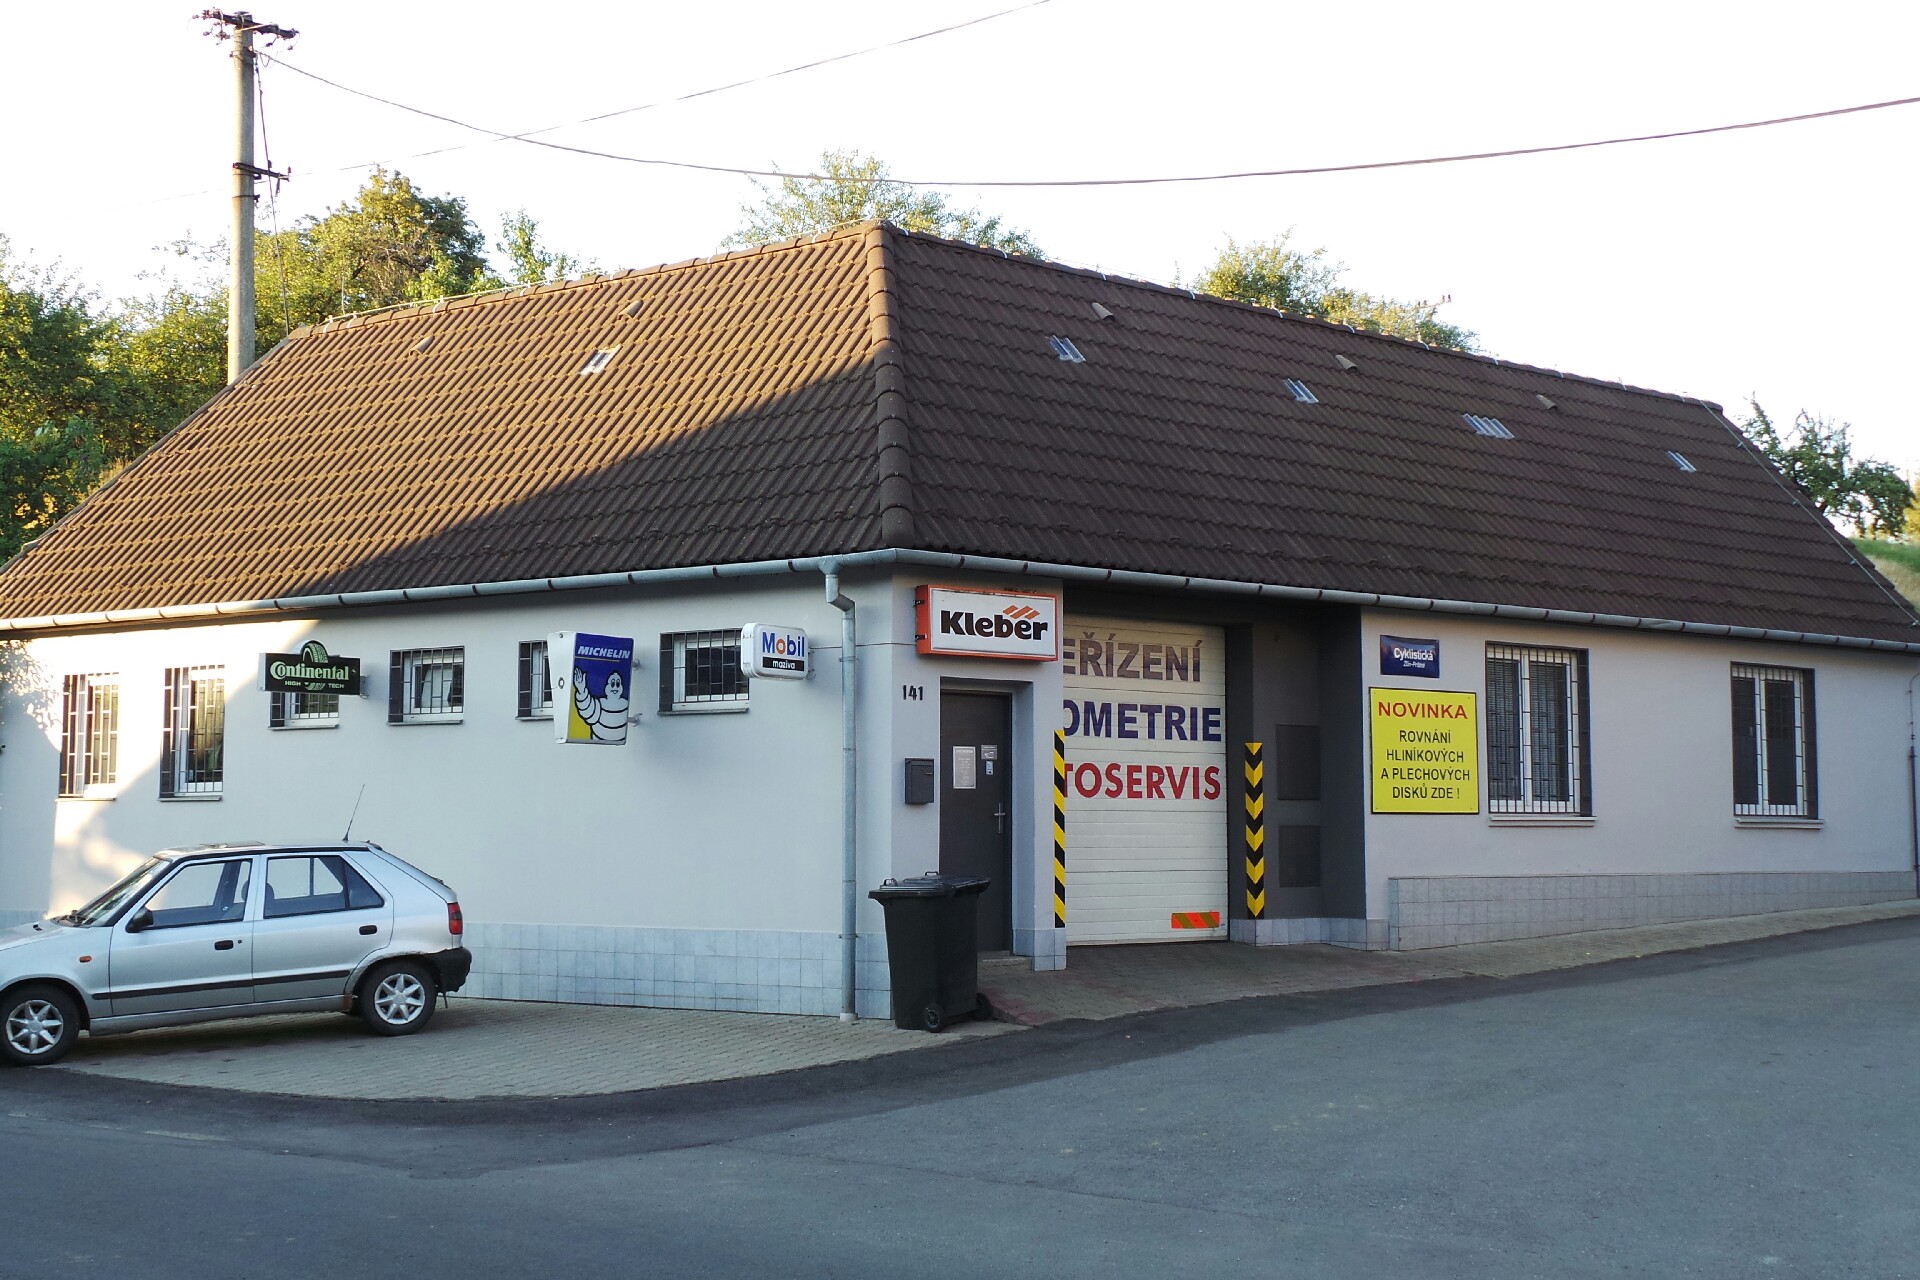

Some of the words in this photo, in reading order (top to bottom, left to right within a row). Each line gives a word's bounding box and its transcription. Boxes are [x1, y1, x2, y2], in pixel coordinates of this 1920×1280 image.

[940, 609, 1048, 641] Kleber
[577, 645, 631, 659] MICHELIN
[762, 631, 805, 658] Mobil
[1393, 647, 1434, 661] Cyklistická
[270, 661, 349, 680] Continental
[772, 660, 796, 670] maziva
[902, 684, 924, 701] 141
[1378, 701, 1468, 720] NOVINKA
[1399, 728, 1451, 744] ROVNÁNÍ
[1386, 746, 1464, 763] HLINÍKOVÝCH
[1380, 767, 1389, 780] A
[1392, 765, 1470, 781] PLECHOVÝCH
[1392, 782, 1428, 799] DISKŮ
[1430, 787, 1454, 799] ZDE
